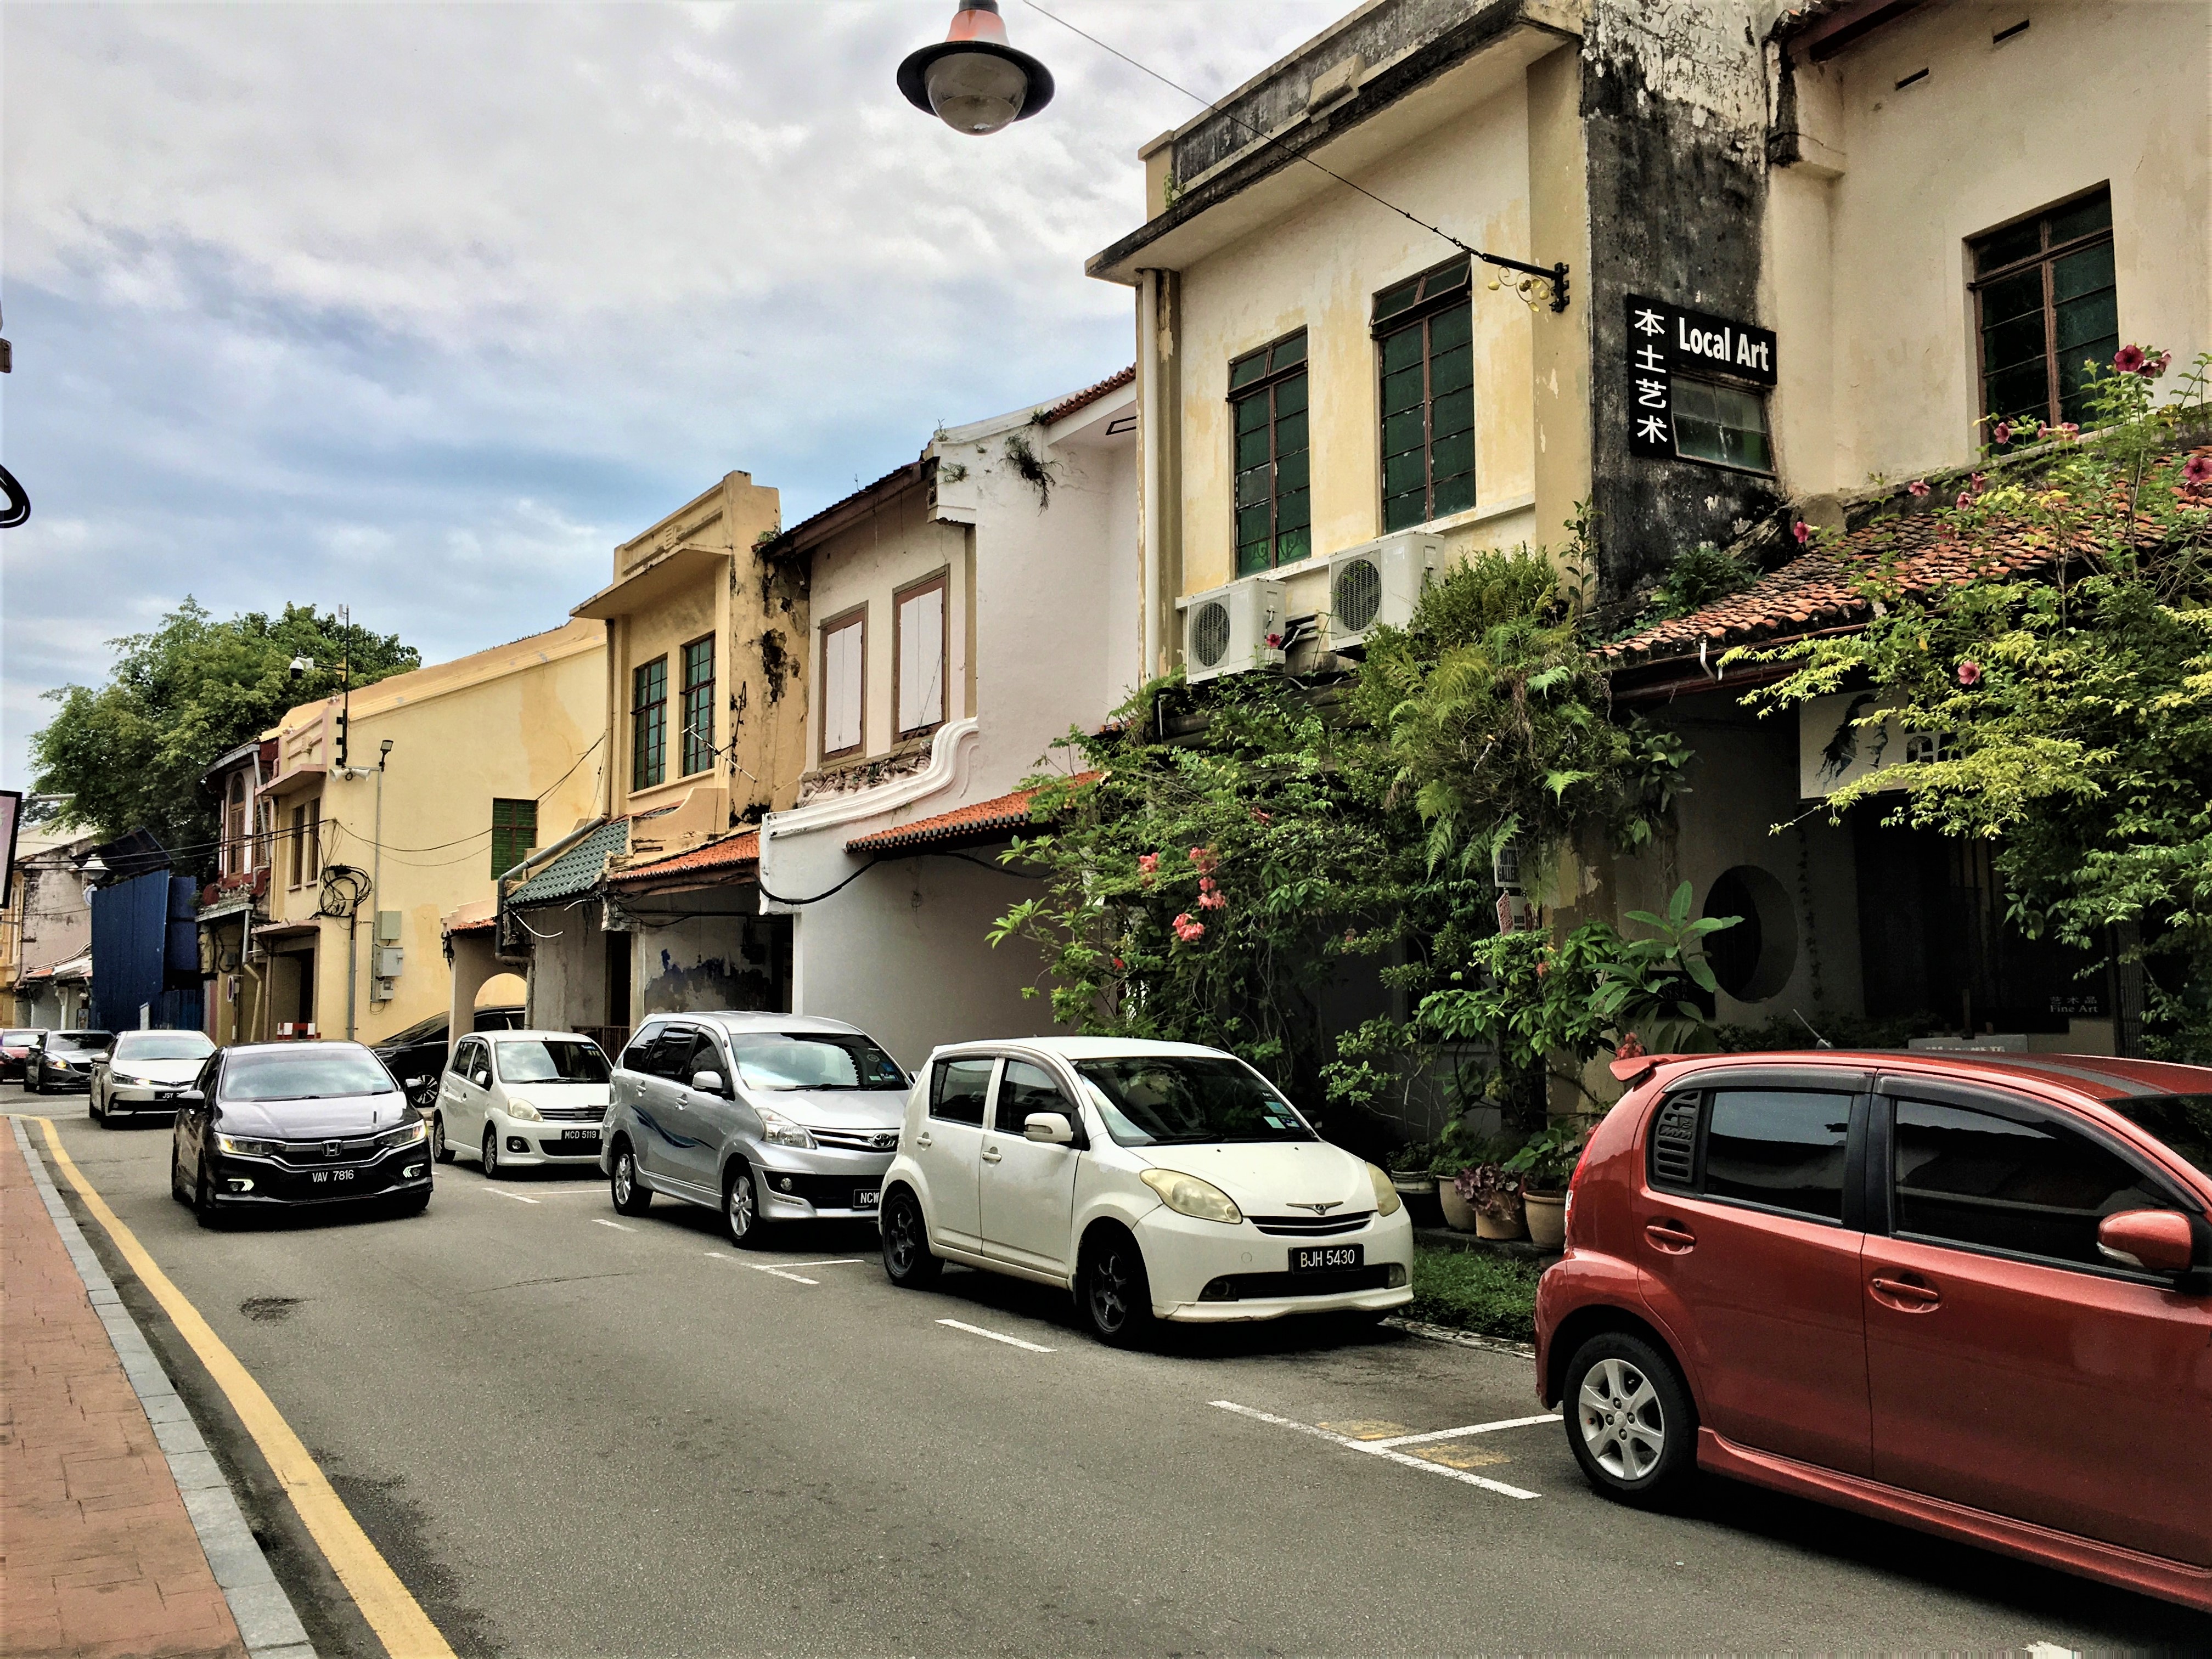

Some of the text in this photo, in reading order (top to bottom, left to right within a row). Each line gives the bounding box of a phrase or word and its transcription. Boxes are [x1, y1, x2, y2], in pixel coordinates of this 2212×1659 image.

[1679, 317, 1769, 371] Local Art
[1634, 309, 1668, 443] 本土艺术
[2079, 1005, 2098, 1013] Art
[565, 1131, 579, 1139] MCD
[312, 1170, 354, 1182] VAV 7816
[860, 1192, 880, 1203] NCW
[1301, 1249, 1355, 1267] BJH 5430
